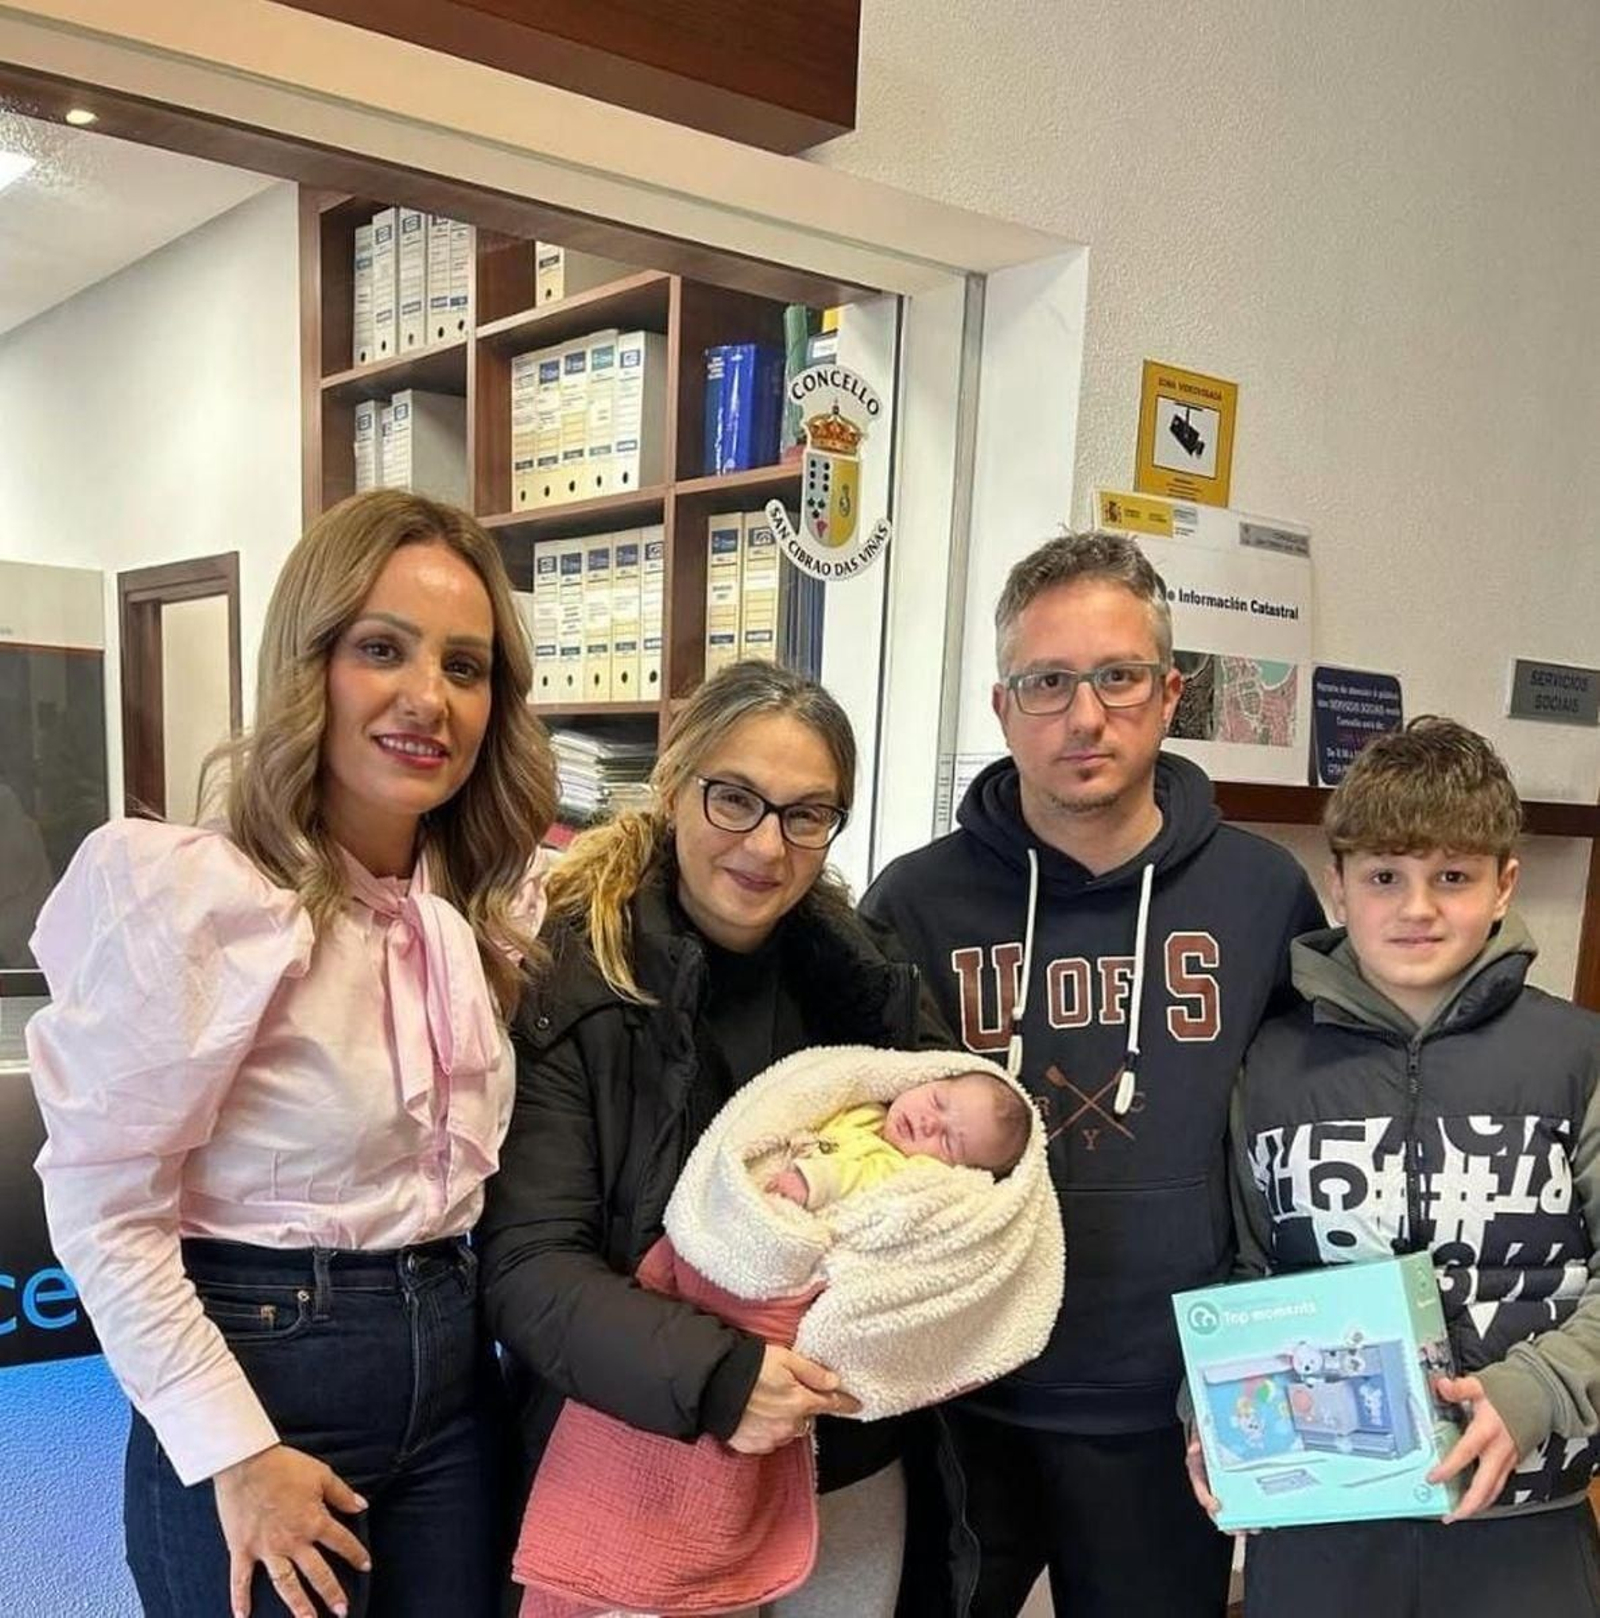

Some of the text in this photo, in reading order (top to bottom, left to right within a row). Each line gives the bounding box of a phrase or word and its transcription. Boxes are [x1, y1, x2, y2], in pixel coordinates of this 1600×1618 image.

[791, 370, 880, 416] CONCELLO
[769, 506, 888, 577] SAN CIBRAO DAS VIÑAS
[1178, 588, 1248, 611] Información
[1250, 600, 1299, 620] Catastral
[1535, 694, 1580, 713] SOCIAIS
[952, 932, 1220, 1053] U OF S
[1082, 1129, 1099, 1150] Y
